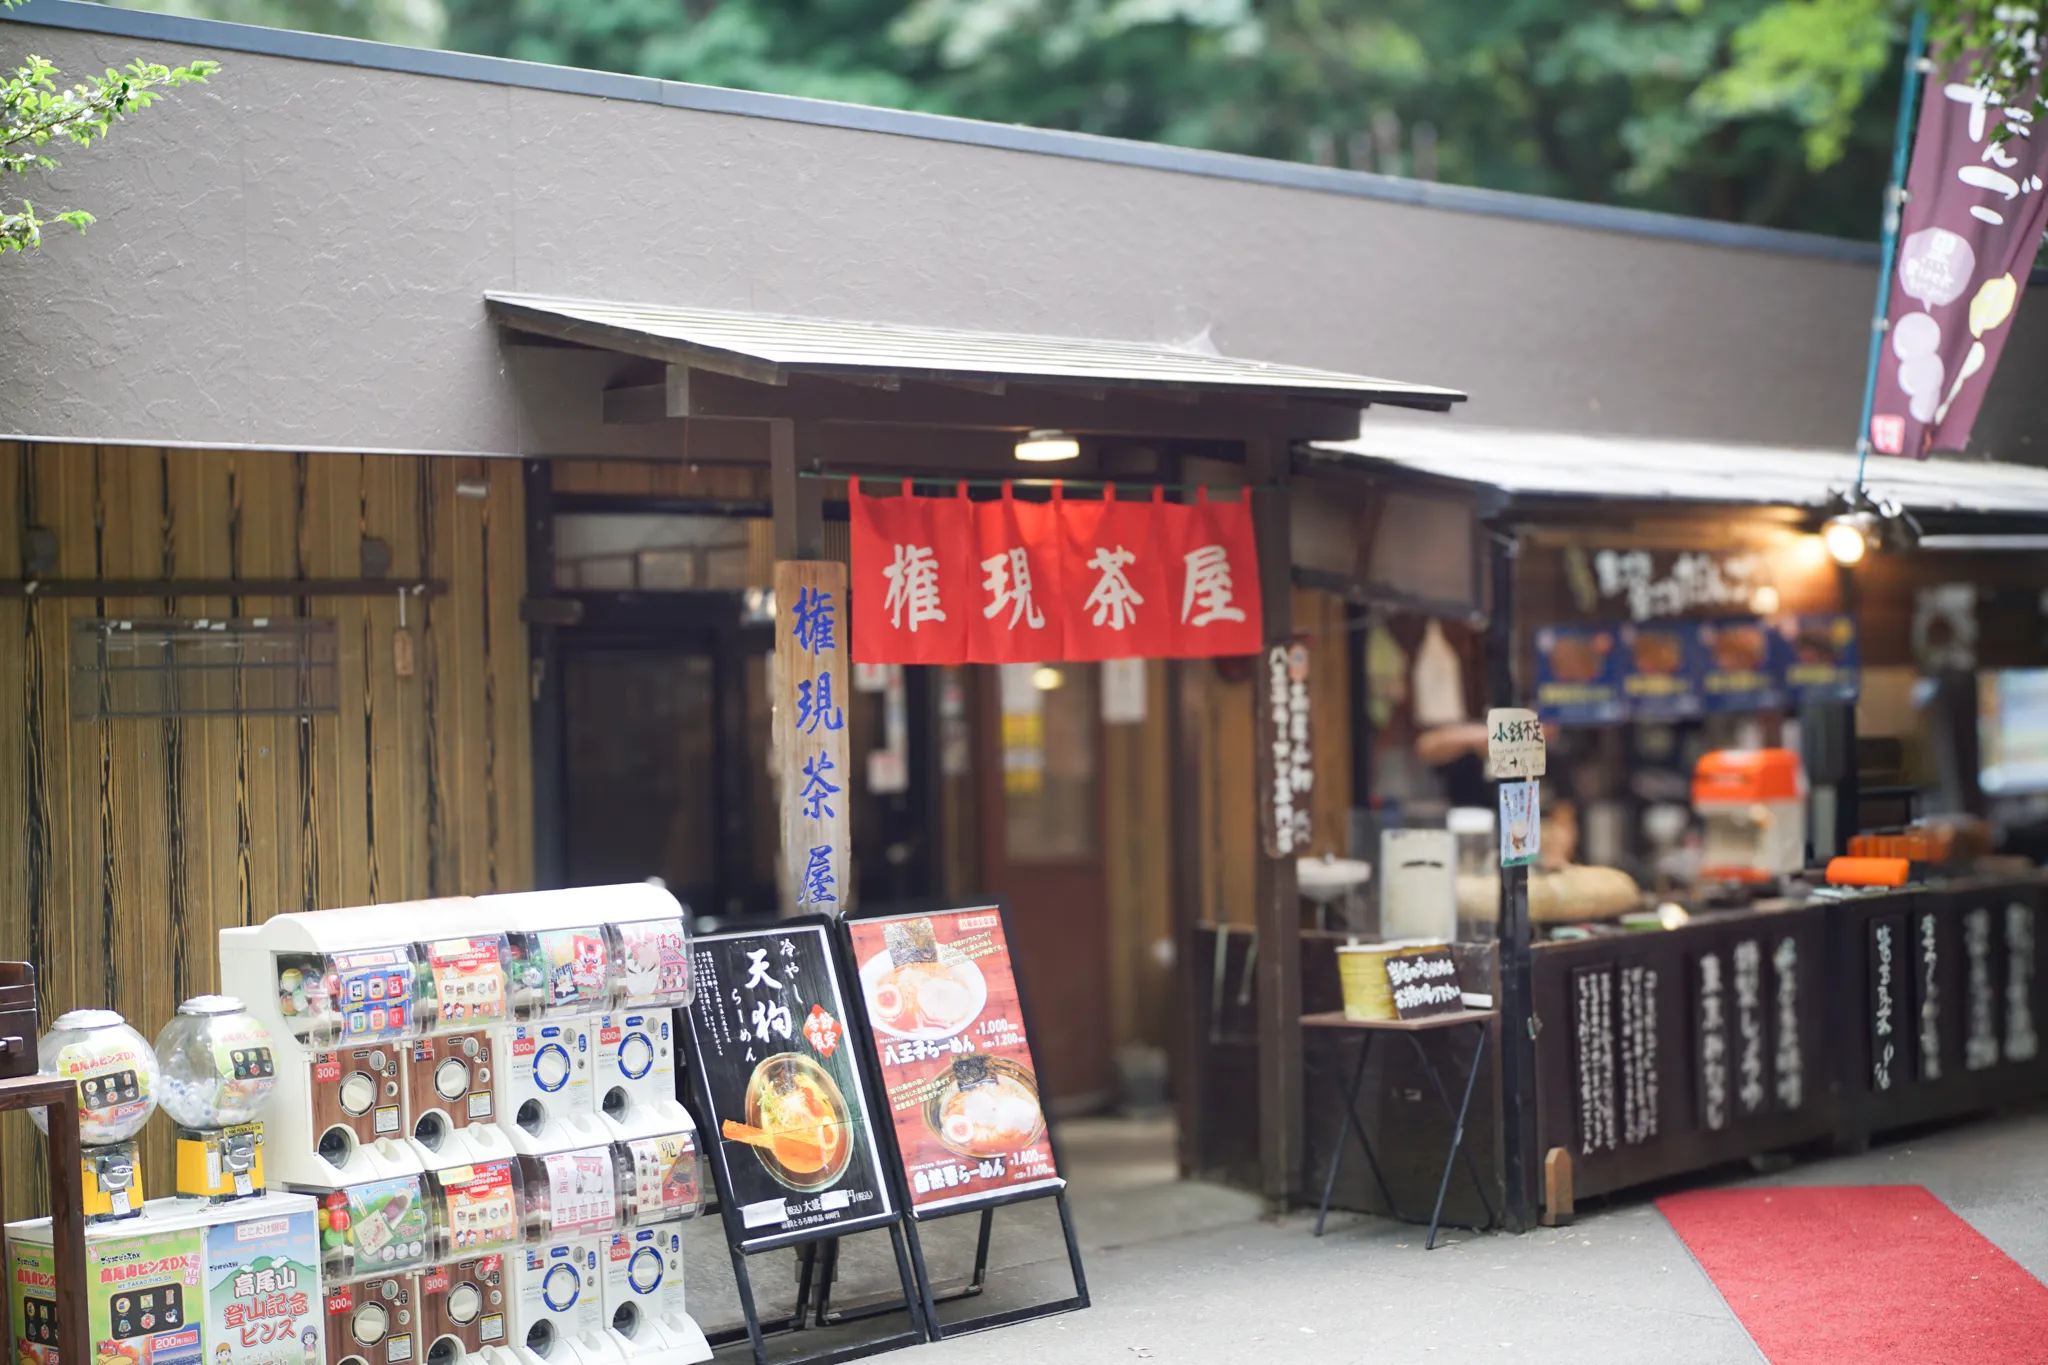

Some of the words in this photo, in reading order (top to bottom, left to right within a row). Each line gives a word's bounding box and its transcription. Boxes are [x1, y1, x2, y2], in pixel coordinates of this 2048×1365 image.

[883, 543, 1246, 632] 権現茶屋
[792, 586, 844, 904] 権現茶屋
[779, 937, 806, 1004] 冷やし
[744, 948, 793, 1043] 天狗
[731, 988, 757, 1062] らーめん
[806, 1010, 835, 1032] 季節
[809, 1030, 838, 1051] 限定
[884, 1034, 976, 1066] 八王子らーめん
[317, 1067, 341, 1079] 300円
[239, 1220, 288, 1238] ここだけ限定
[234, 1266, 298, 1299] 高尾山
[224, 1292, 309, 1330] 登山記念
[240, 1316, 298, 1347] ピンズ
